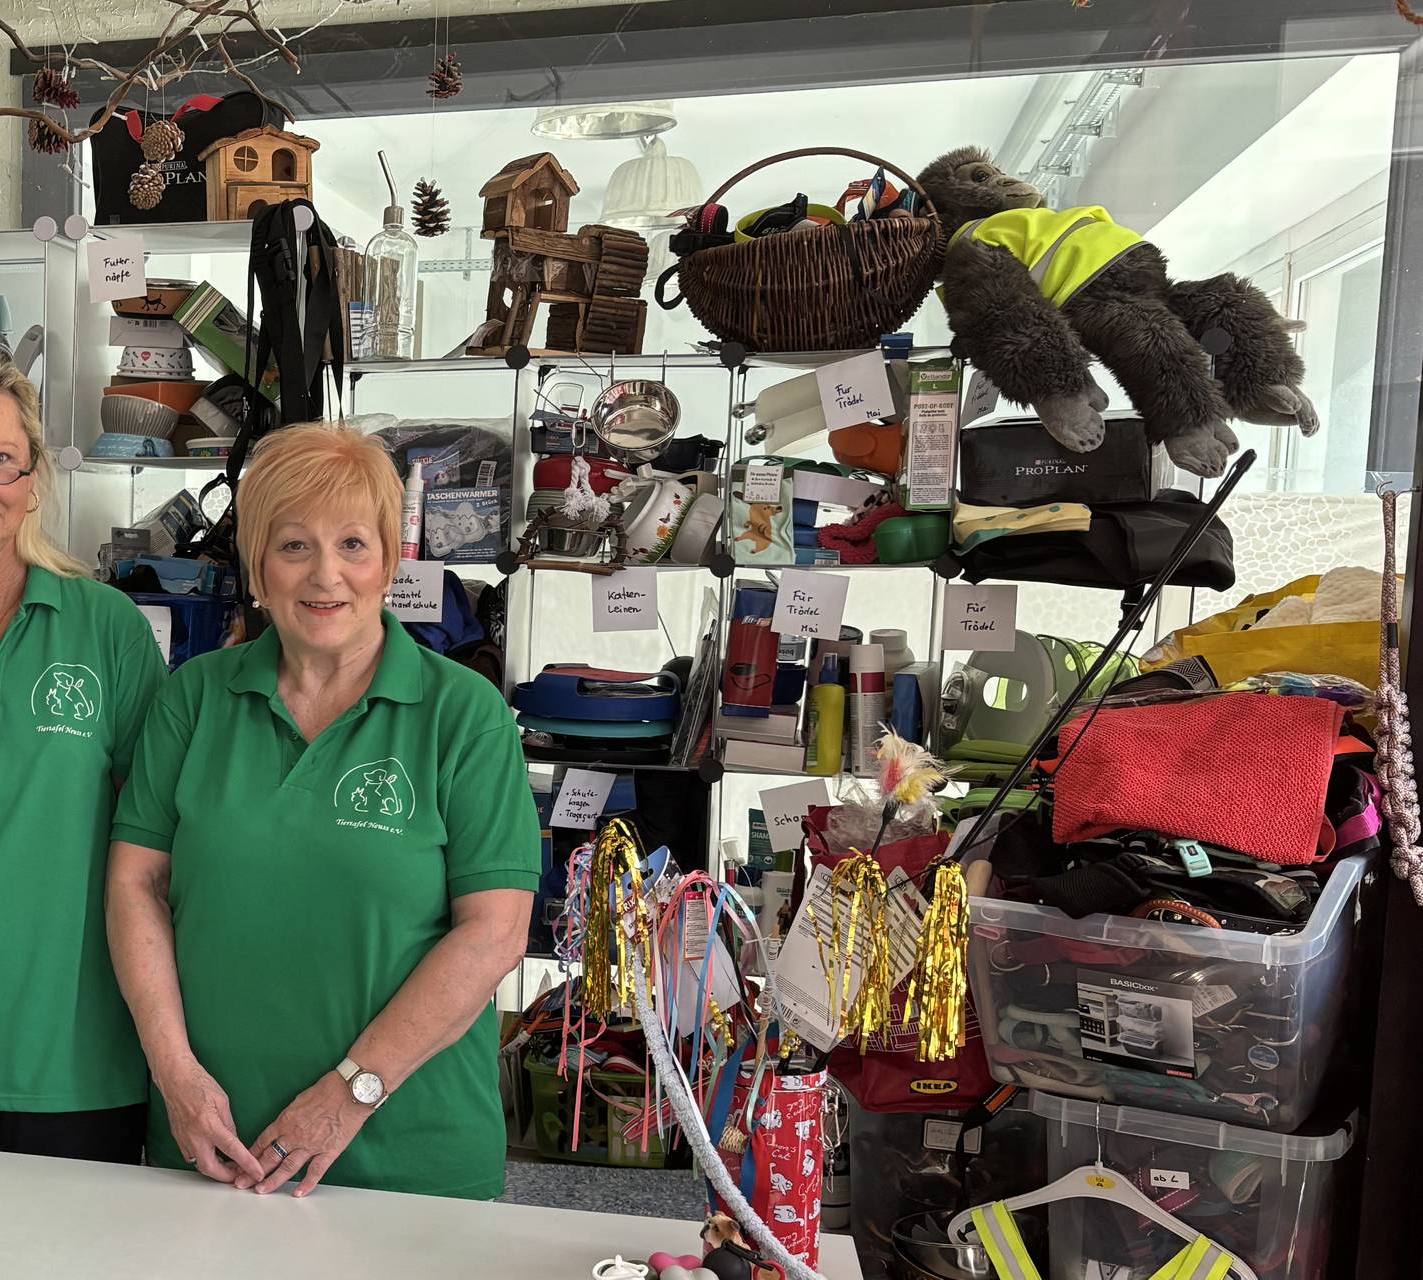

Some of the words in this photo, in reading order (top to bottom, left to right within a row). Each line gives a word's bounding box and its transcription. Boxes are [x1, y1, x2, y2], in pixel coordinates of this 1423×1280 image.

[865, 408, 882, 419] Mai
[966, 602, 986, 614] Für
[916, 1082, 953, 1090] IKEA
